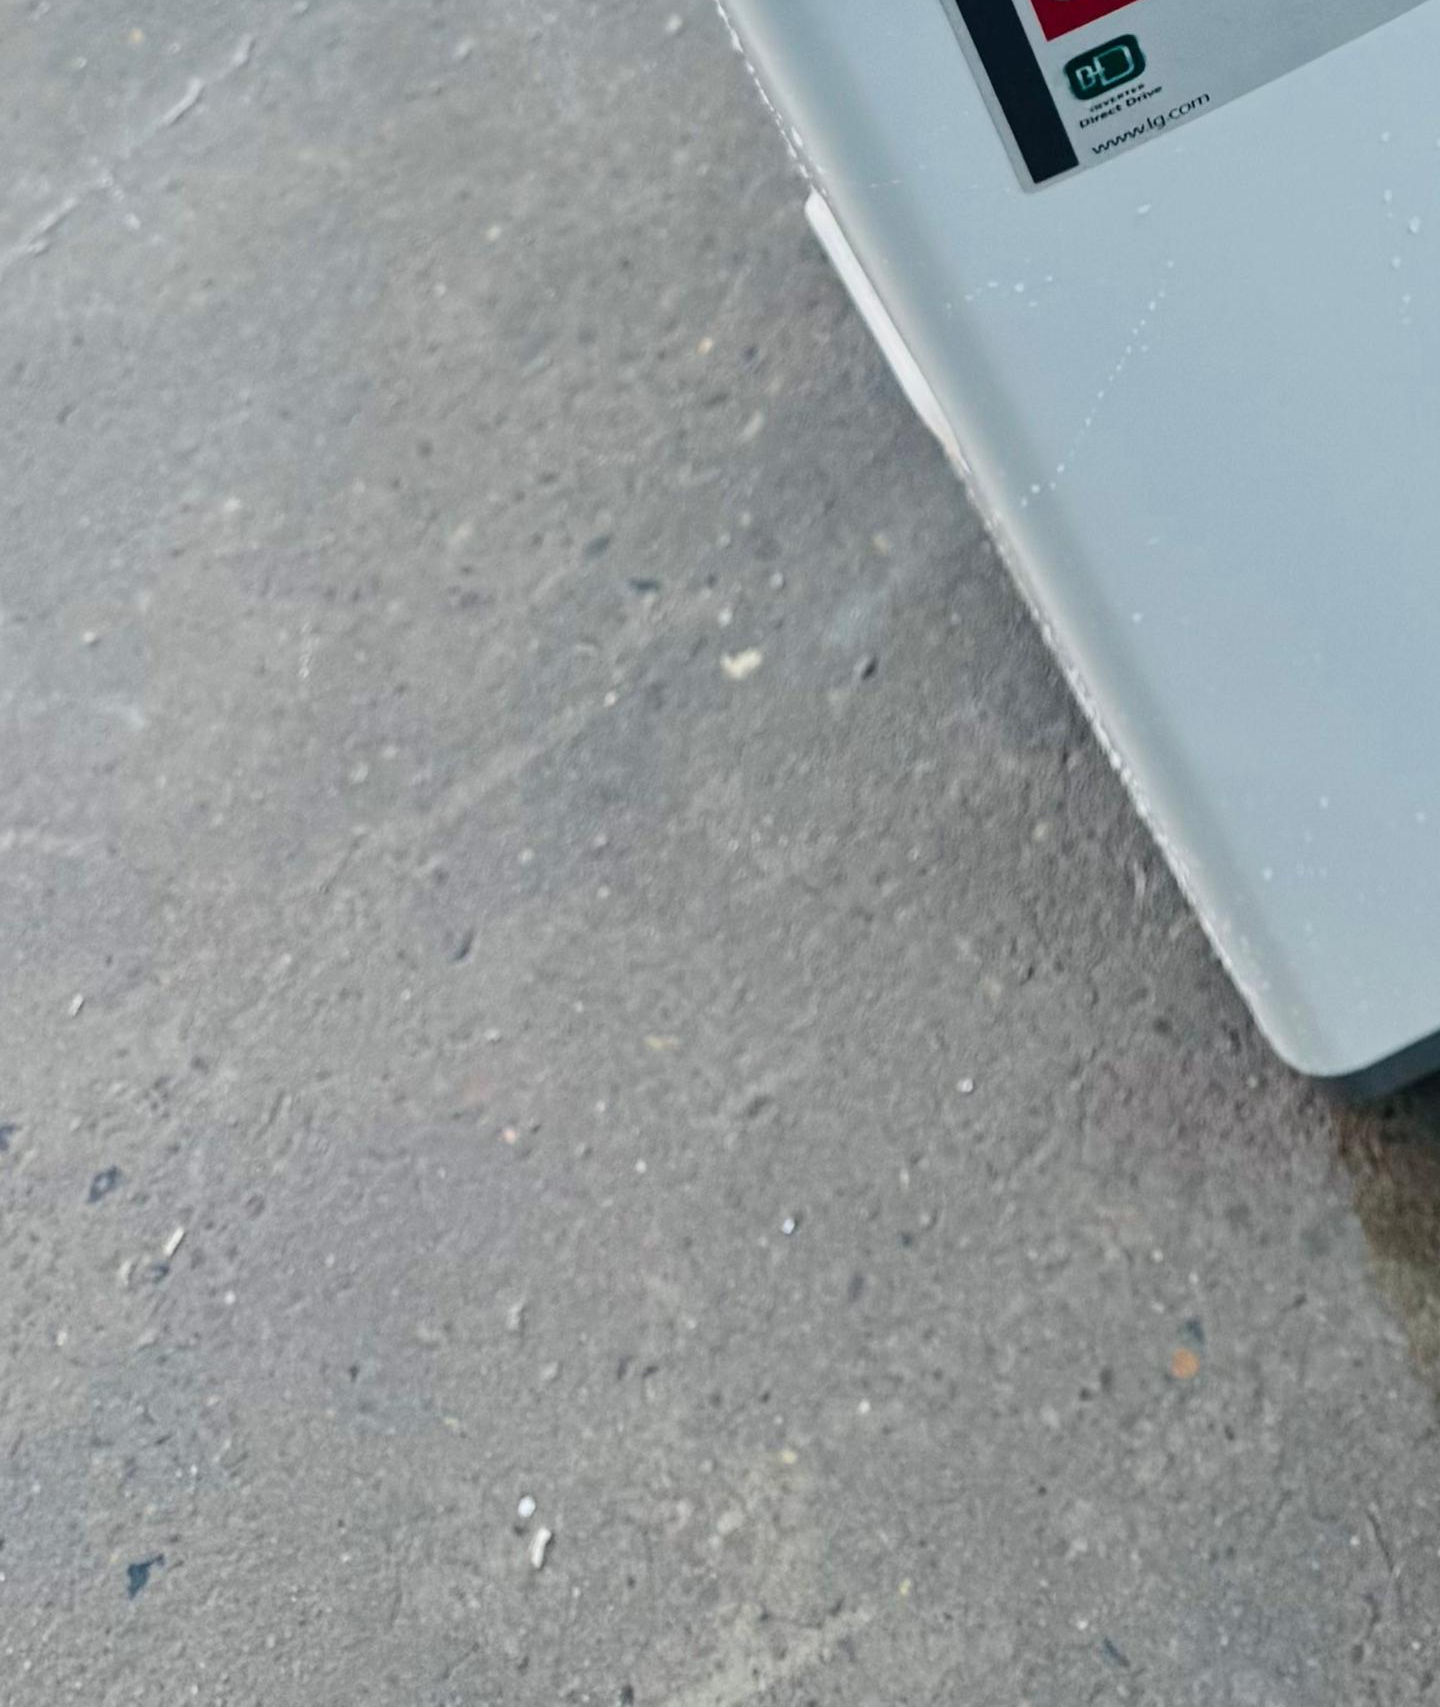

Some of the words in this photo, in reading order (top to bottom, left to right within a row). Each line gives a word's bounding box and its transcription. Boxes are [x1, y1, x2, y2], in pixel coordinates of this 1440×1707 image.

[1079, 104, 1123, 129] Direct
[1125, 86, 1163, 107] Drive
[1092, 93, 1211, 155] www.lg.com
